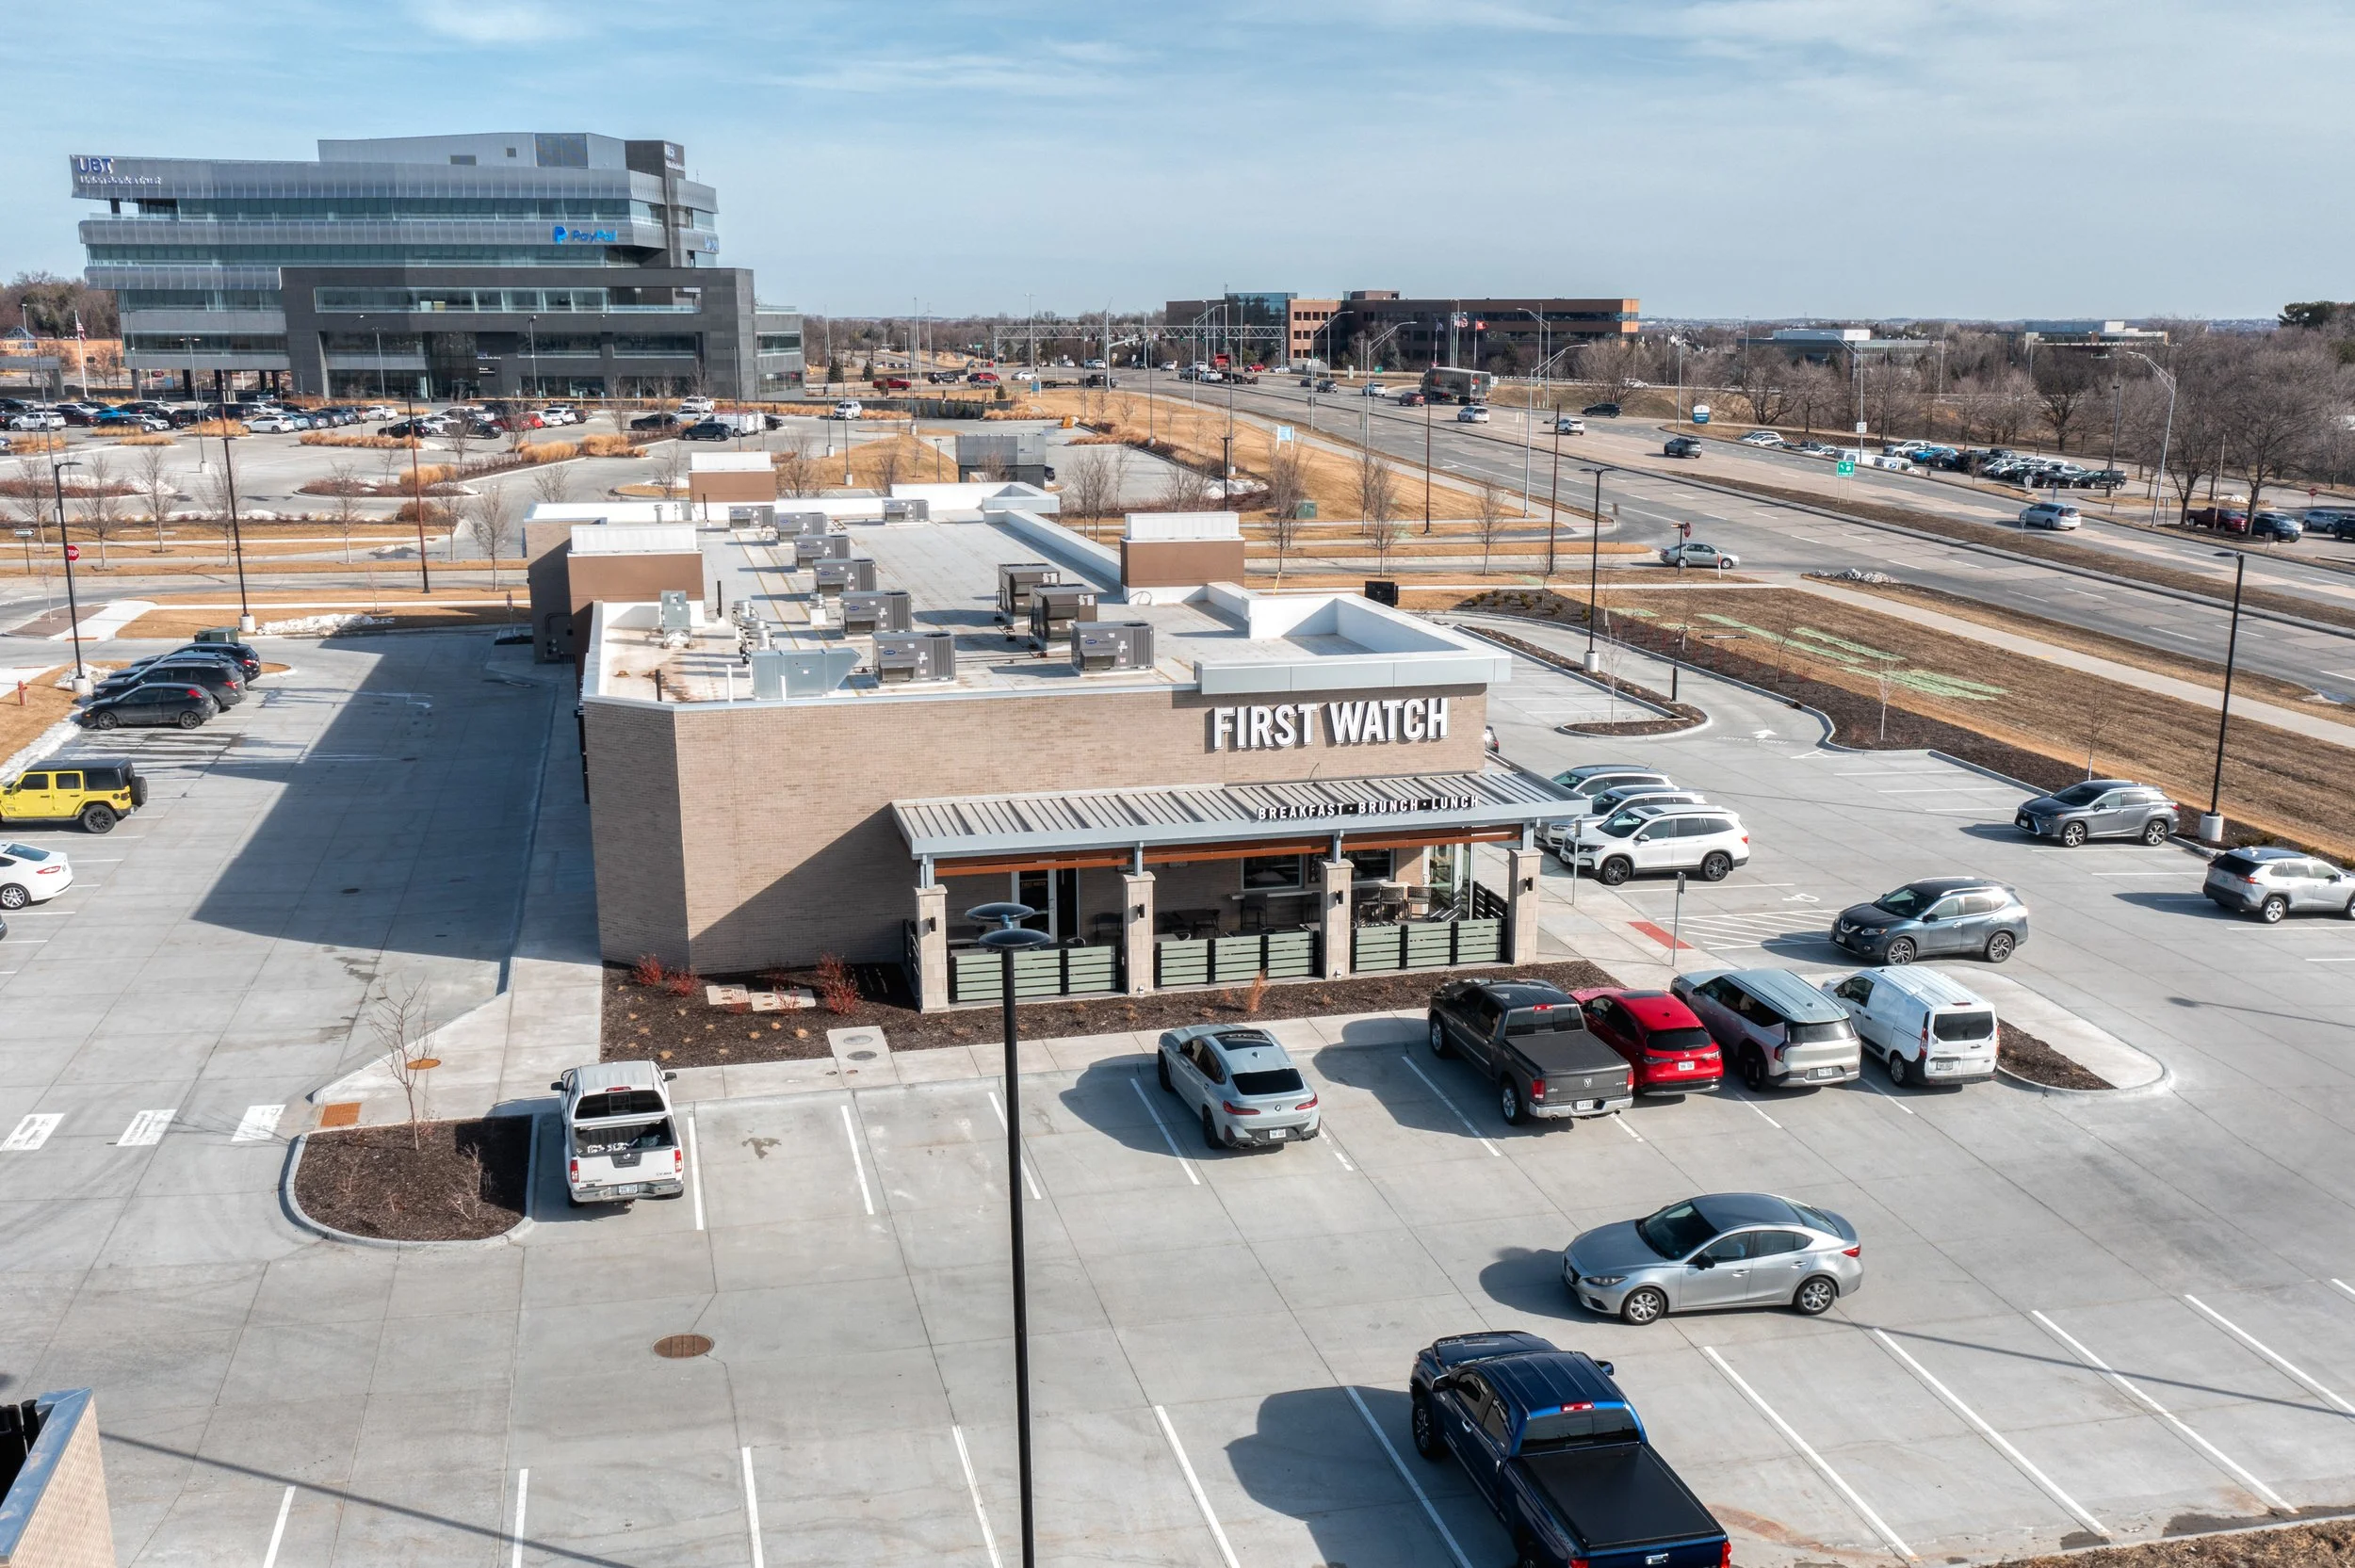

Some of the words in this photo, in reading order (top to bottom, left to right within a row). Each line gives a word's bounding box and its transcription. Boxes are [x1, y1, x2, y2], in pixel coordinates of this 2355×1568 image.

[77, 157, 113, 173] UBT
[573, 229, 618, 243] PayPal
[1214, 703, 1319, 750] FIRST
[1329, 696, 1451, 744] WATCH
[1258, 802, 1344, 820] BREAKFAST
[1357, 799, 1419, 815] BRUNCH
[1431, 795, 1479, 810] LUNCH
